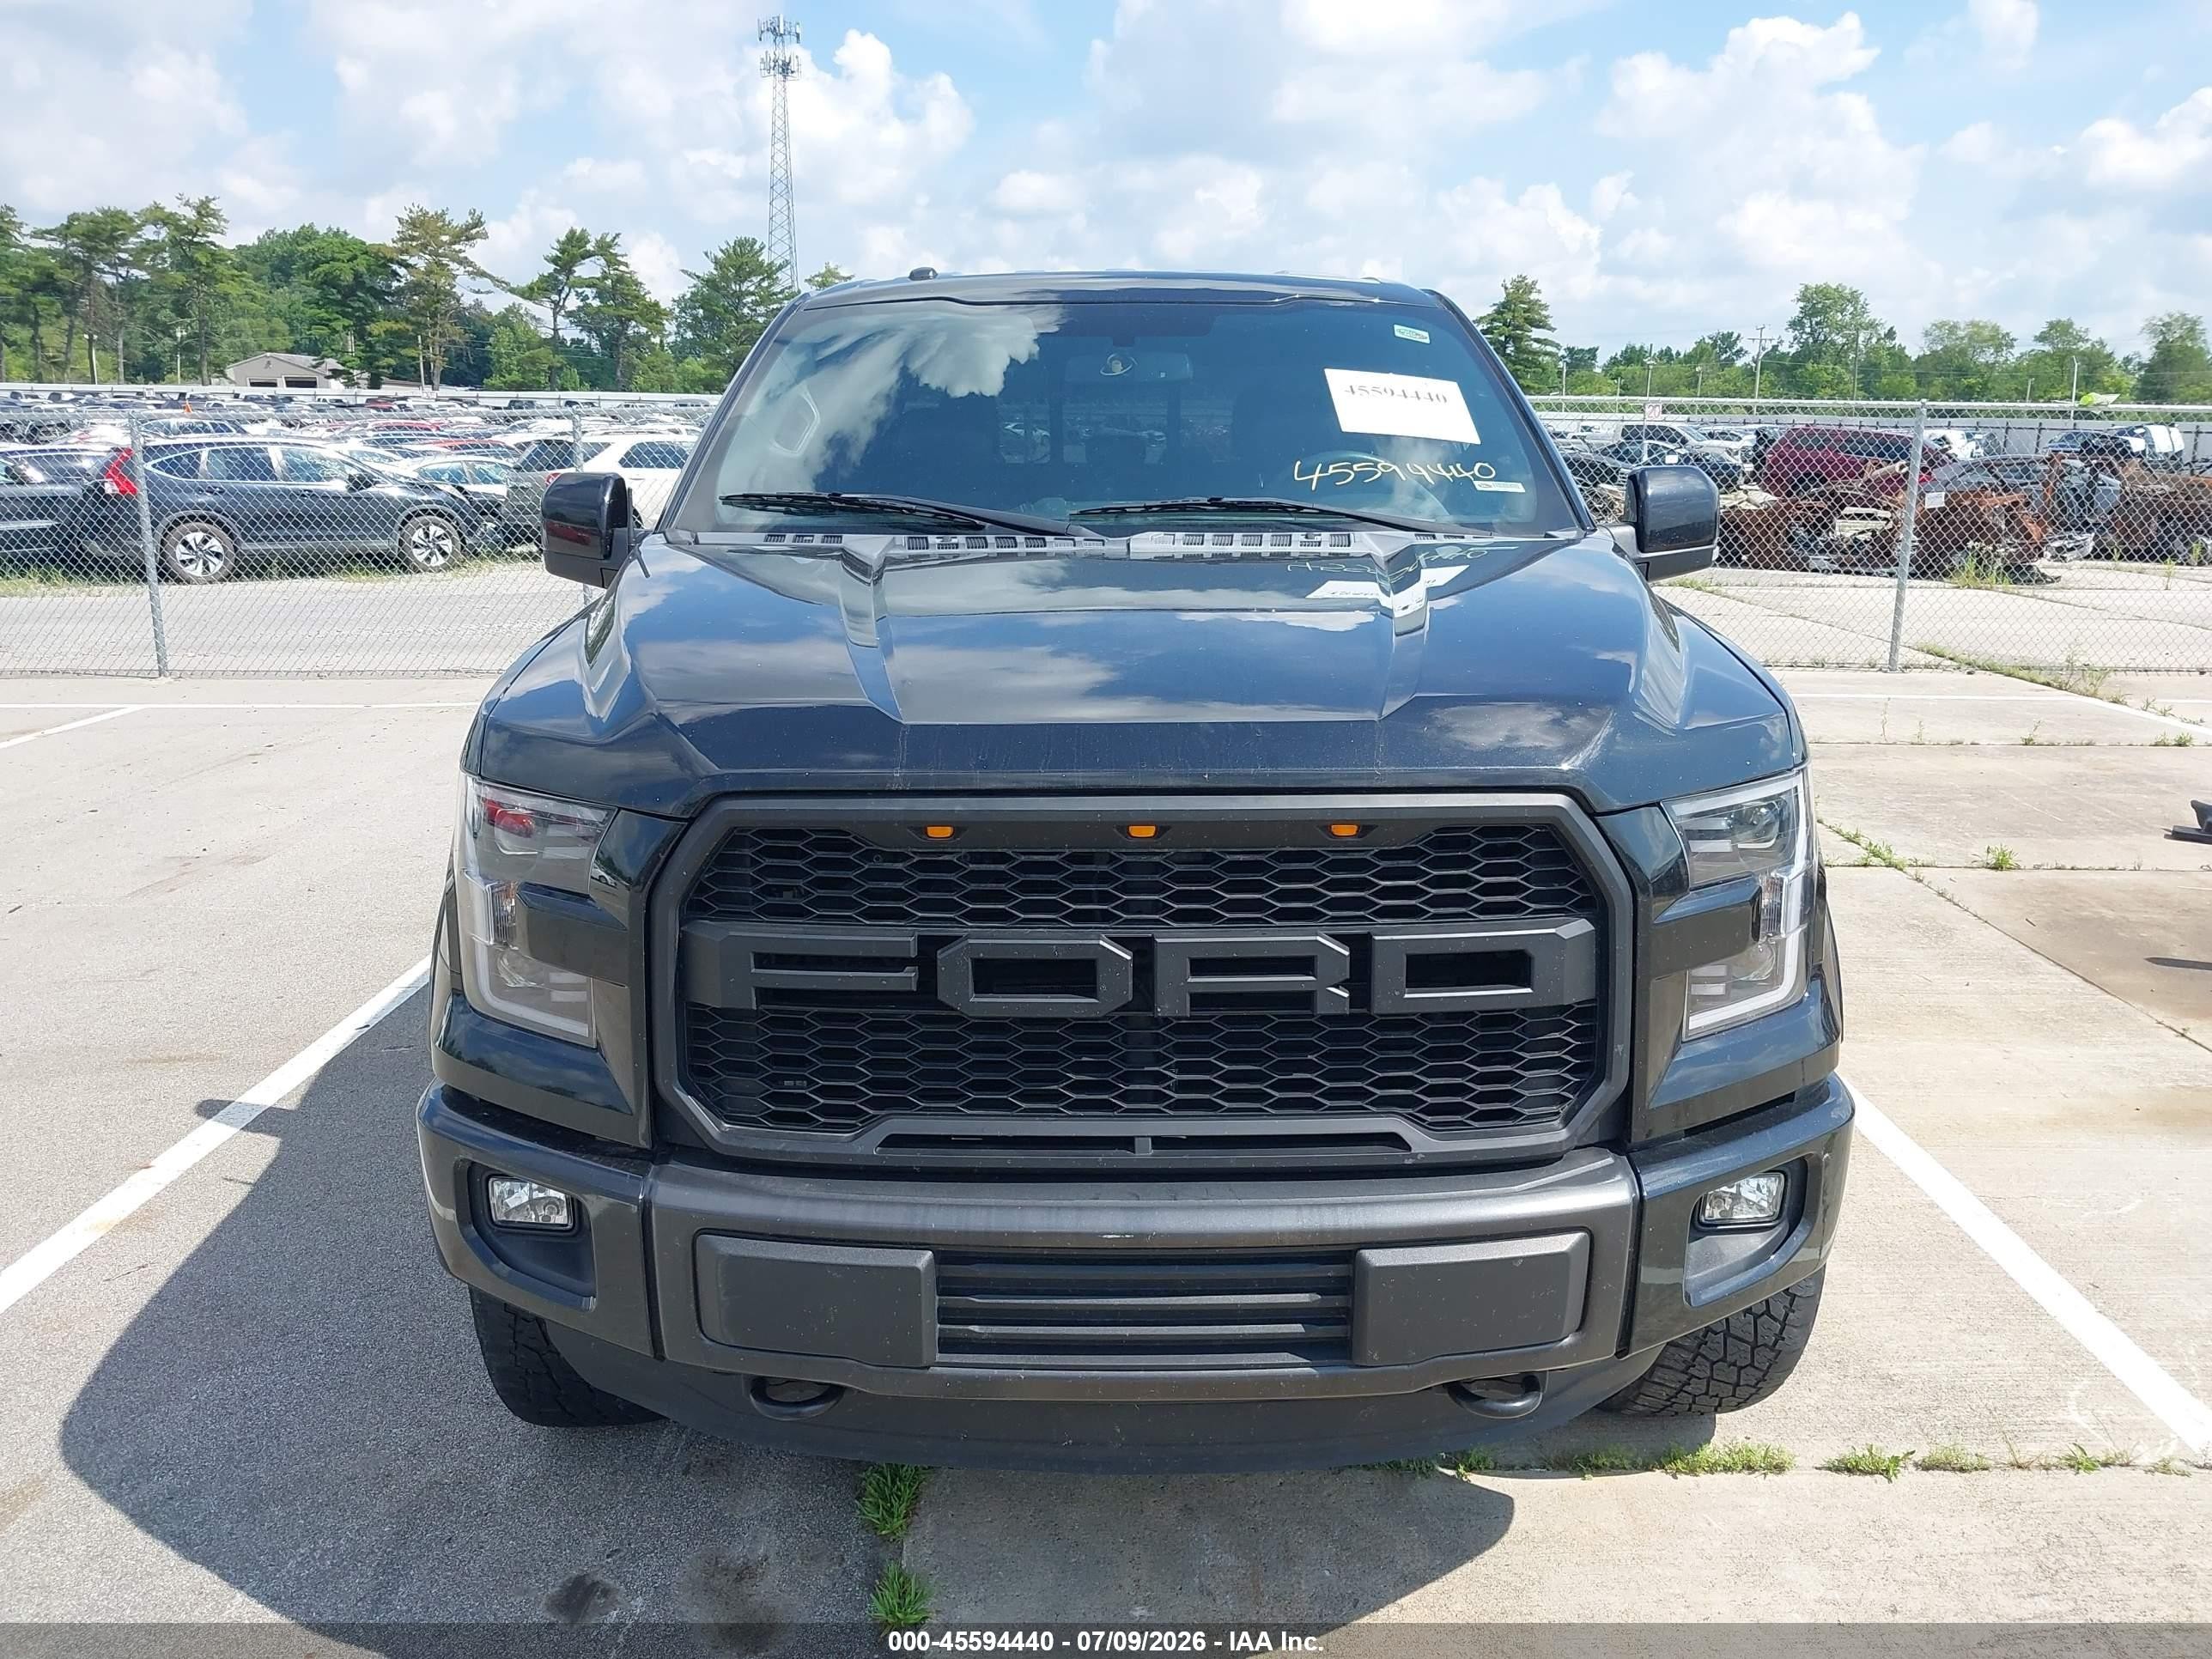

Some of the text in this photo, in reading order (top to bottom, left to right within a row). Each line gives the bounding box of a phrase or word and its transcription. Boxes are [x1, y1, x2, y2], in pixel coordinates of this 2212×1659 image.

[1648, 404, 1661, 418] 20
[1294, 460, 1496, 490] 45594440
[683, 920, 1595, 1017] FORD
